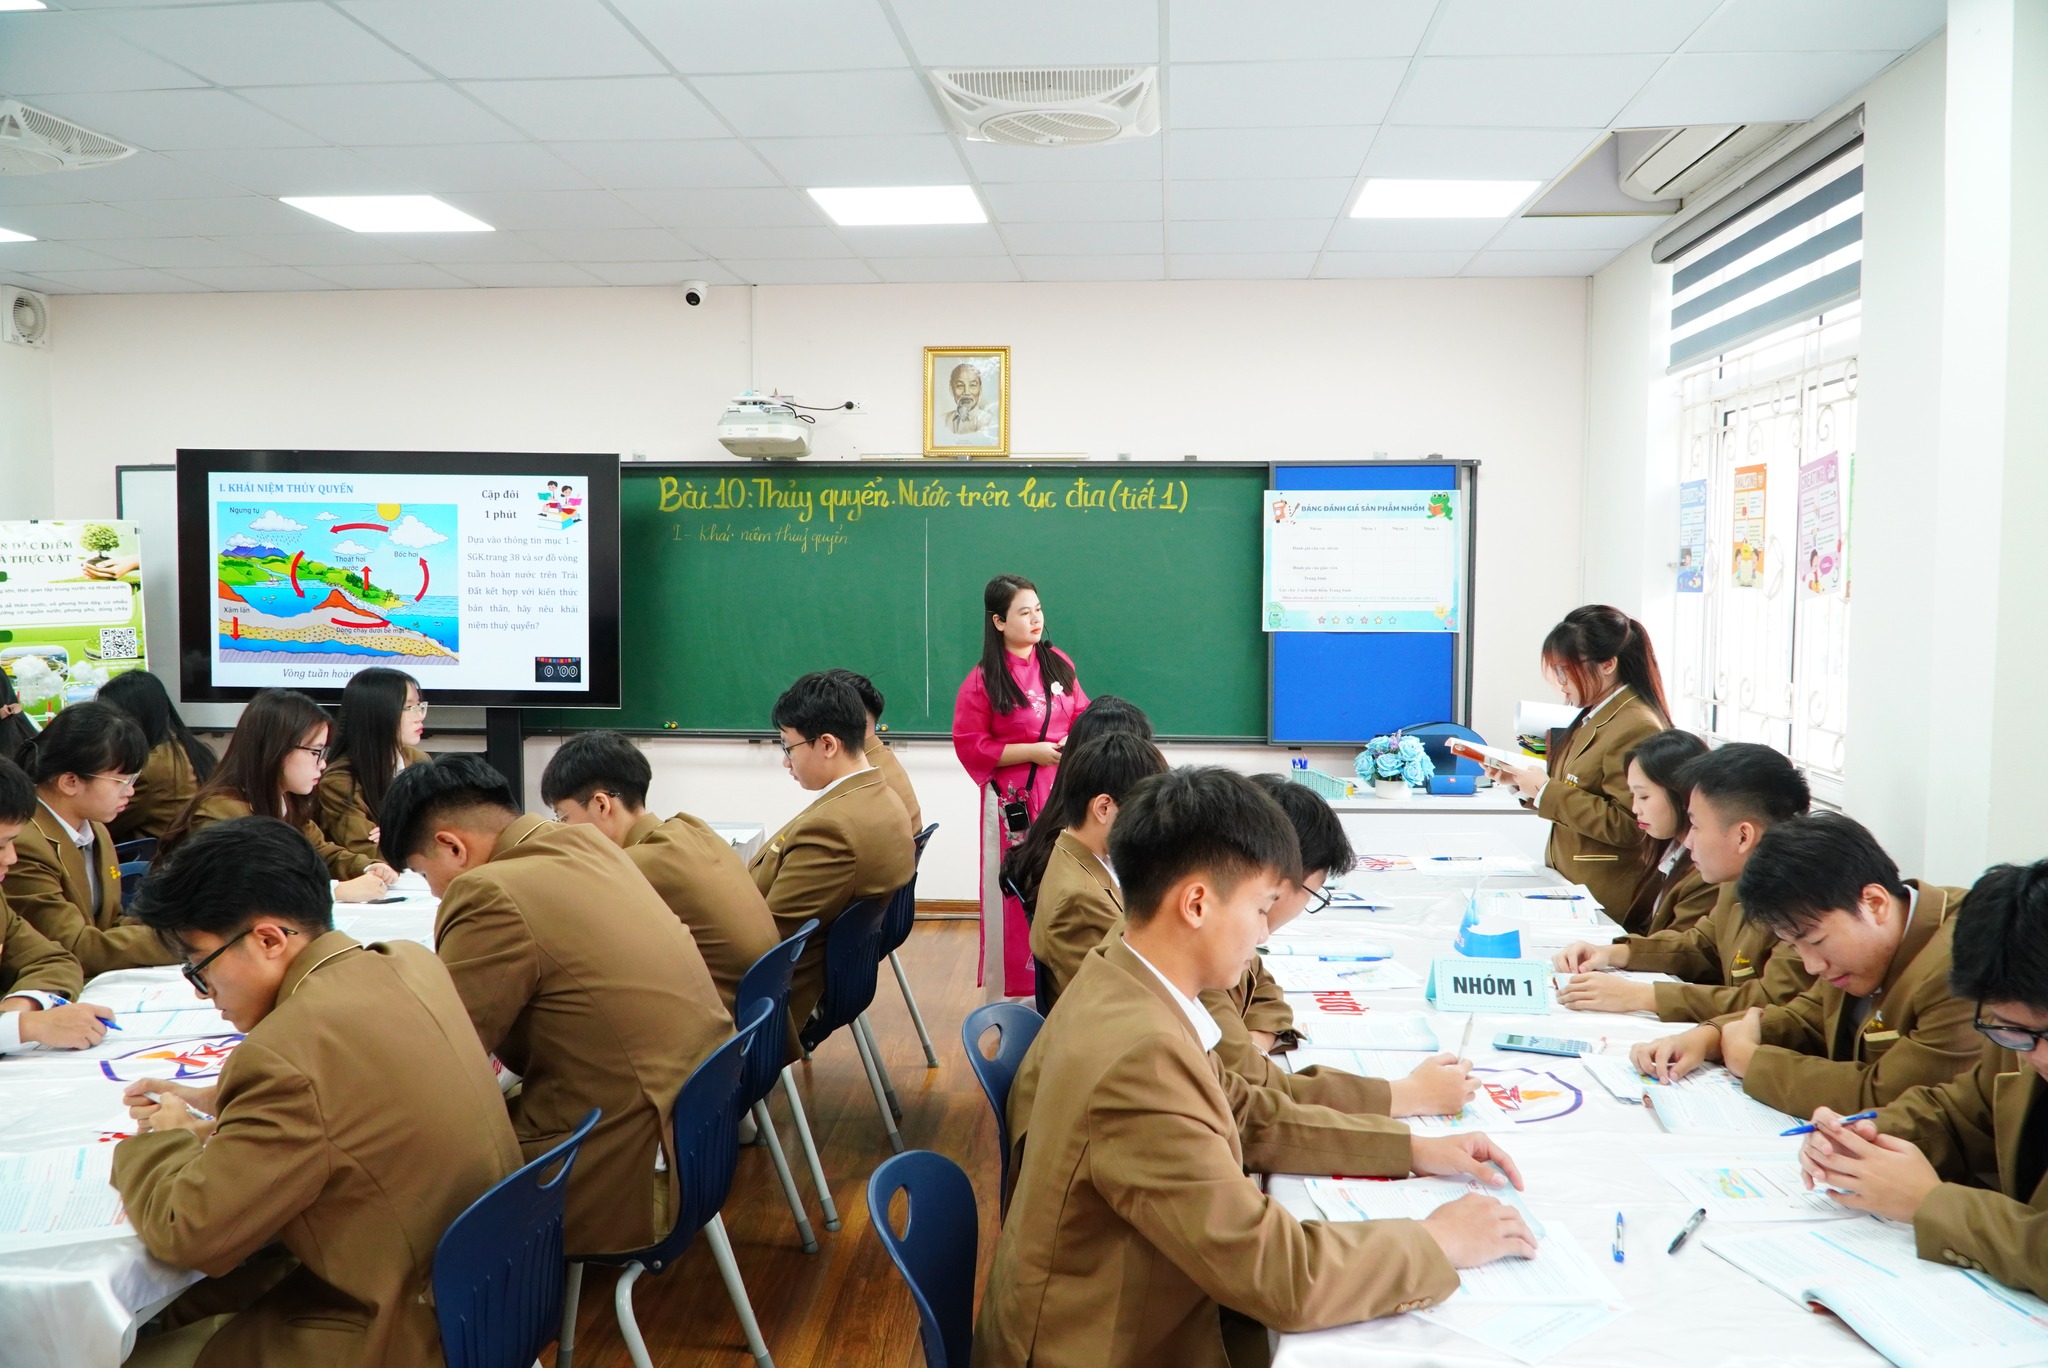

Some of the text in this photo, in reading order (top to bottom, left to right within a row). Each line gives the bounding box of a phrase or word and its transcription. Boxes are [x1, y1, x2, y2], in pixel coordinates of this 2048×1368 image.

[228, 481, 254, 493] KHÁI
[257, 482, 284, 494] NIỆM
[286, 482, 316, 494] THỦY
[481, 489, 520, 500] Cặp đôi
[658, 476, 1188, 522] Bài 10: Thủy quyển. Nước trên lục địa (tiết 1)
[1301, 502, 1424, 512] BẢNG ĐÁNH GIÁ SẢN PHẨM NHÓM
[485, 510, 517, 520] 1 phút
[467, 536, 484, 545] Dựa
[487, 536, 502, 544] vào
[504, 536, 528, 546] thông
[544, 538, 562, 546] mục
[10, 554, 45, 565] THỰC
[48, 553, 72, 564] VẬT
[510, 554, 520, 562] 38
[522, 554, 532, 562] và
[534, 554, 543, 562] sơ
[546, 554, 556, 562] đồ
[558, 554, 578, 564] vòng
[467, 568, 578, 579] tuần hoàn nước trên Trái
[468, 587, 578, 597] Đất kết hợp với kiến thức
[468, 604, 578, 614] bản thân, hãy nêu khái
[468, 620, 488, 630] niệm
[283, 668, 355, 680] Vòng tuần hoàn
[1453, 974, 1533, 996] NHÓM 1
